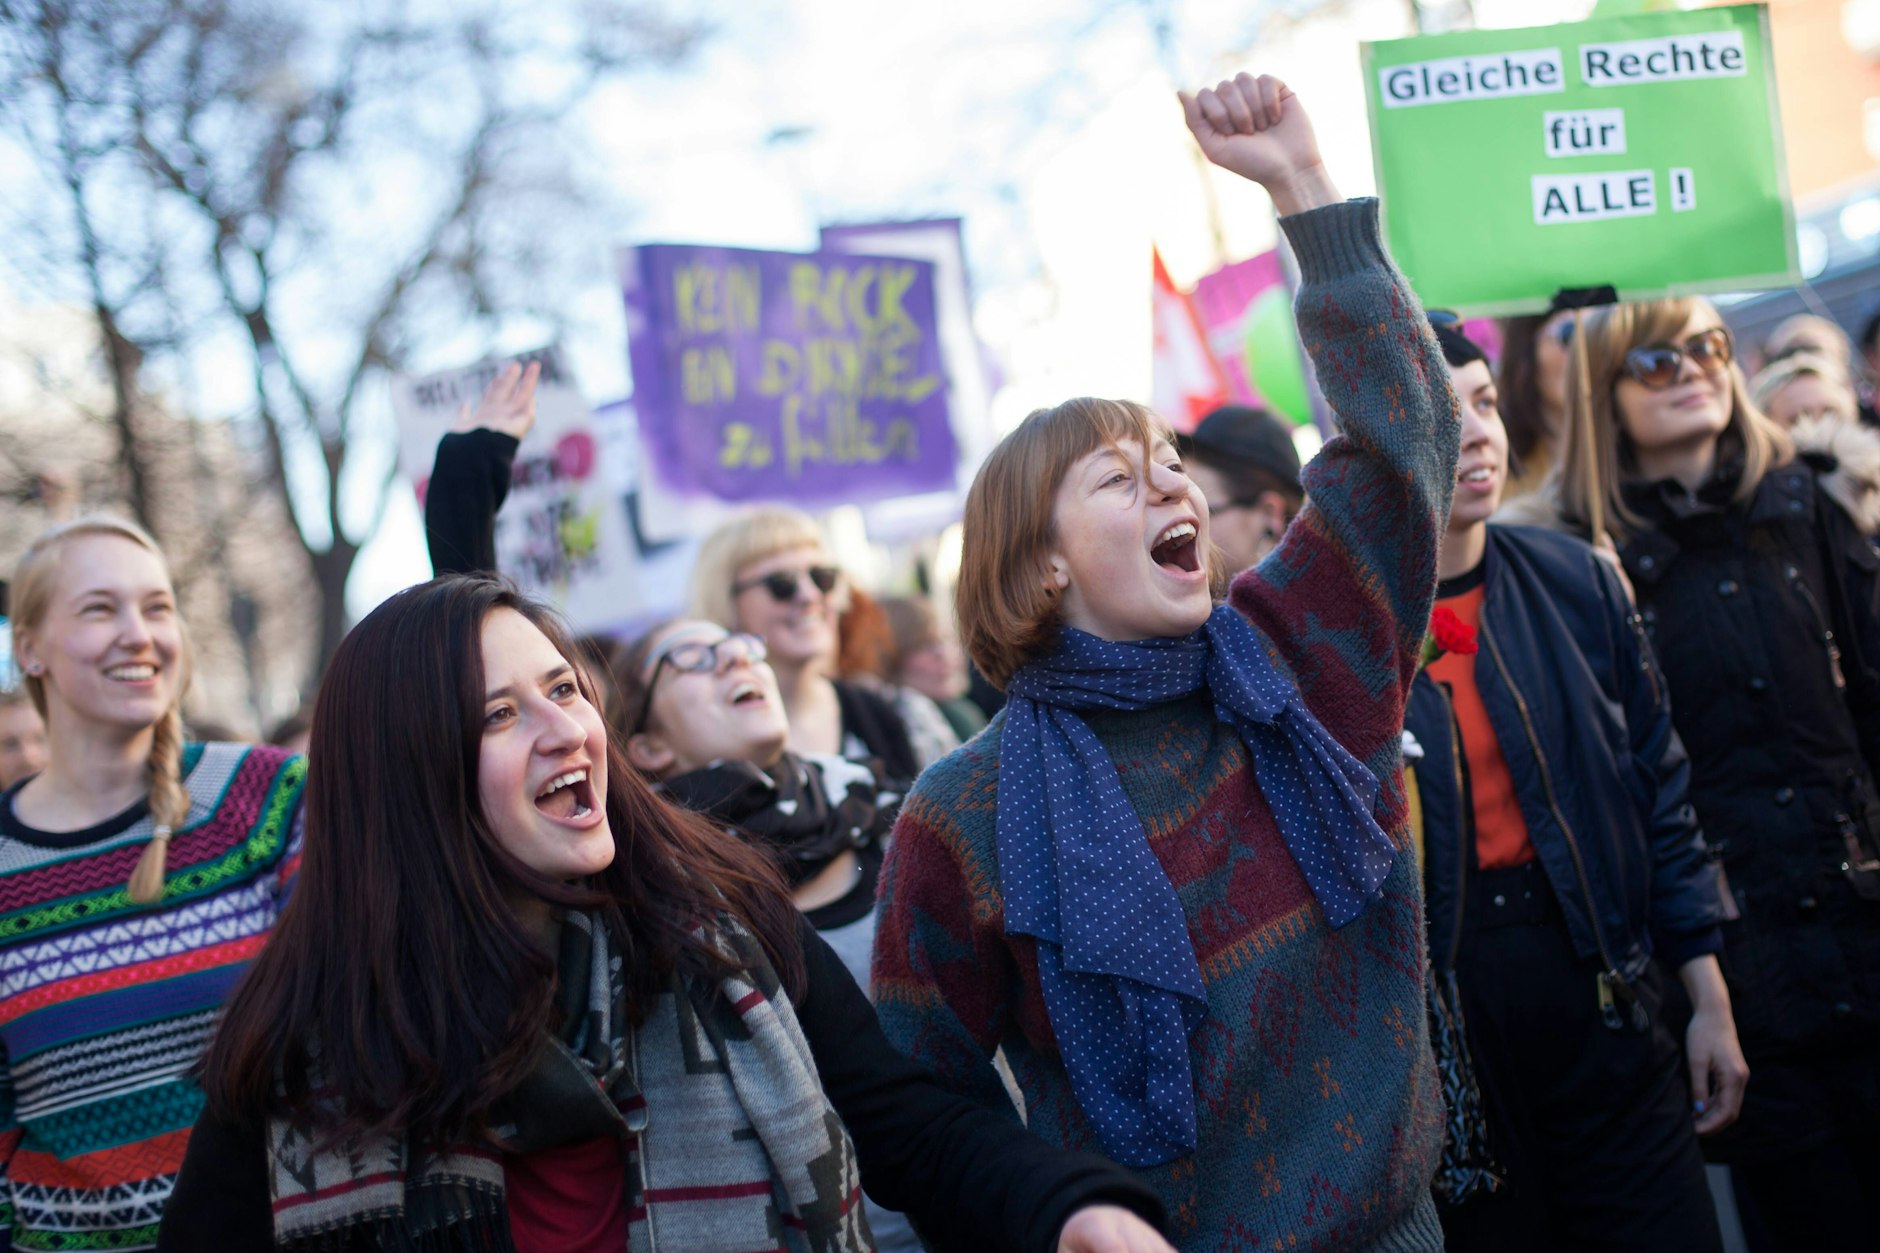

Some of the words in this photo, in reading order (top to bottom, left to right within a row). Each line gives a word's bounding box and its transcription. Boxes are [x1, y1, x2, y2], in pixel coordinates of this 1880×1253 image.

[1387, 58, 1559, 101] Gleiche
[1585, 41, 1744, 80] Rechte
[1549, 116, 1617, 151] für
[1542, 177, 1653, 217] ALLE
[1676, 174, 1688, 205] !
